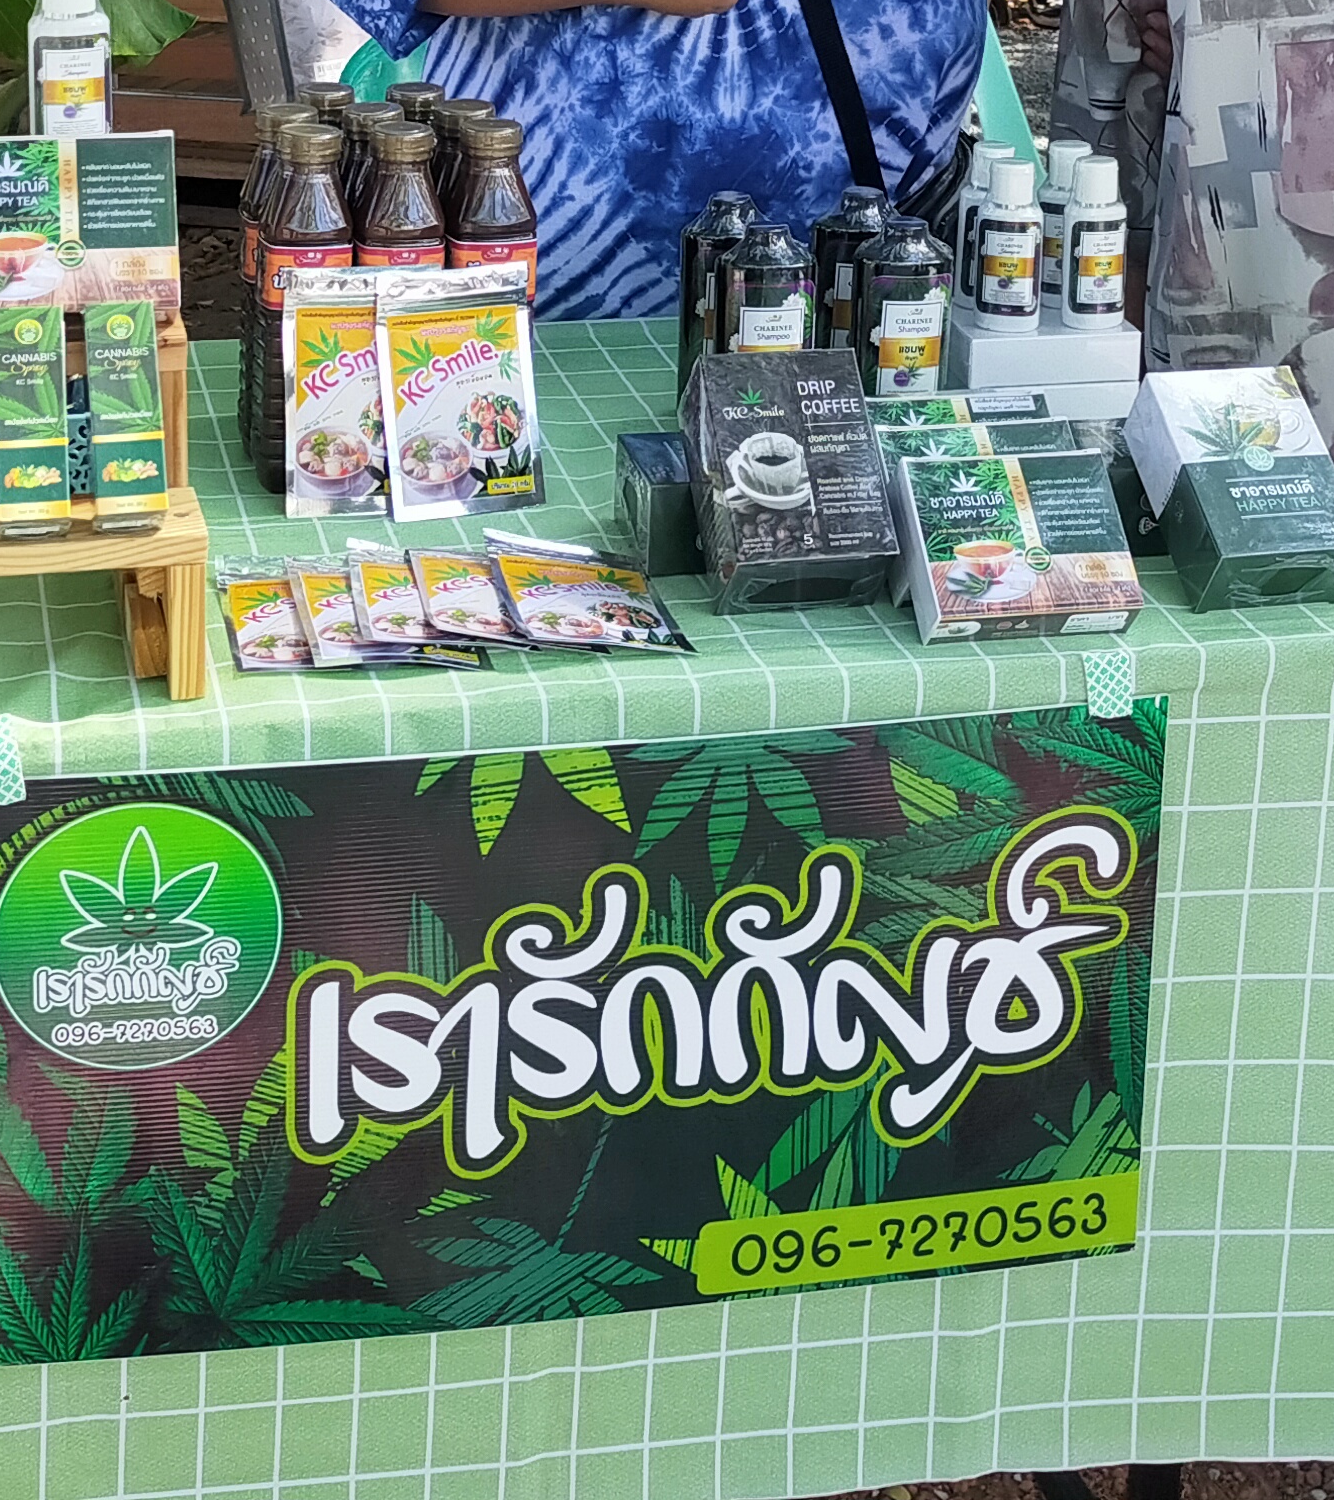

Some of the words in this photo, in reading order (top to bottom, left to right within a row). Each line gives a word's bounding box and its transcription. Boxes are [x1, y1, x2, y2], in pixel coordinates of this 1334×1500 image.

[16, 196, 39, 206] TEA
[756, 332, 791, 342] Shampoo
[897, 325, 931, 335] Shampoo
[1, 352, 57, 364] CANNABIS
[94, 347, 150, 359] CANNABIS
[898, 344, 926, 357] แชมพู
[303, 363, 340, 400] KC
[400, 369, 435, 407] KC
[796, 379, 836, 396] DRIP
[801, 398, 861, 415] COFFEE
[1229, 478, 1315, 498] ชาอารมณ์ดี
[928, 490, 1005, 509] ชาอารมณ์ดี
[1235, 497, 1288, 512] HAPPY
[1288, 495, 1322, 509] TEA
[943, 509, 977, 520] HAPPY
[978, 508, 1000, 518] TEA
[803, 533, 814, 545] 5
[375, 586, 405, 601] KC
[435, 578, 467, 594] KC
[520, 585, 553, 600] KC
[243, 603, 277, 623] KC
[53, 1017, 217, 1047] 096-7270563
[731, 1193, 1111, 1279] 096-7270563
